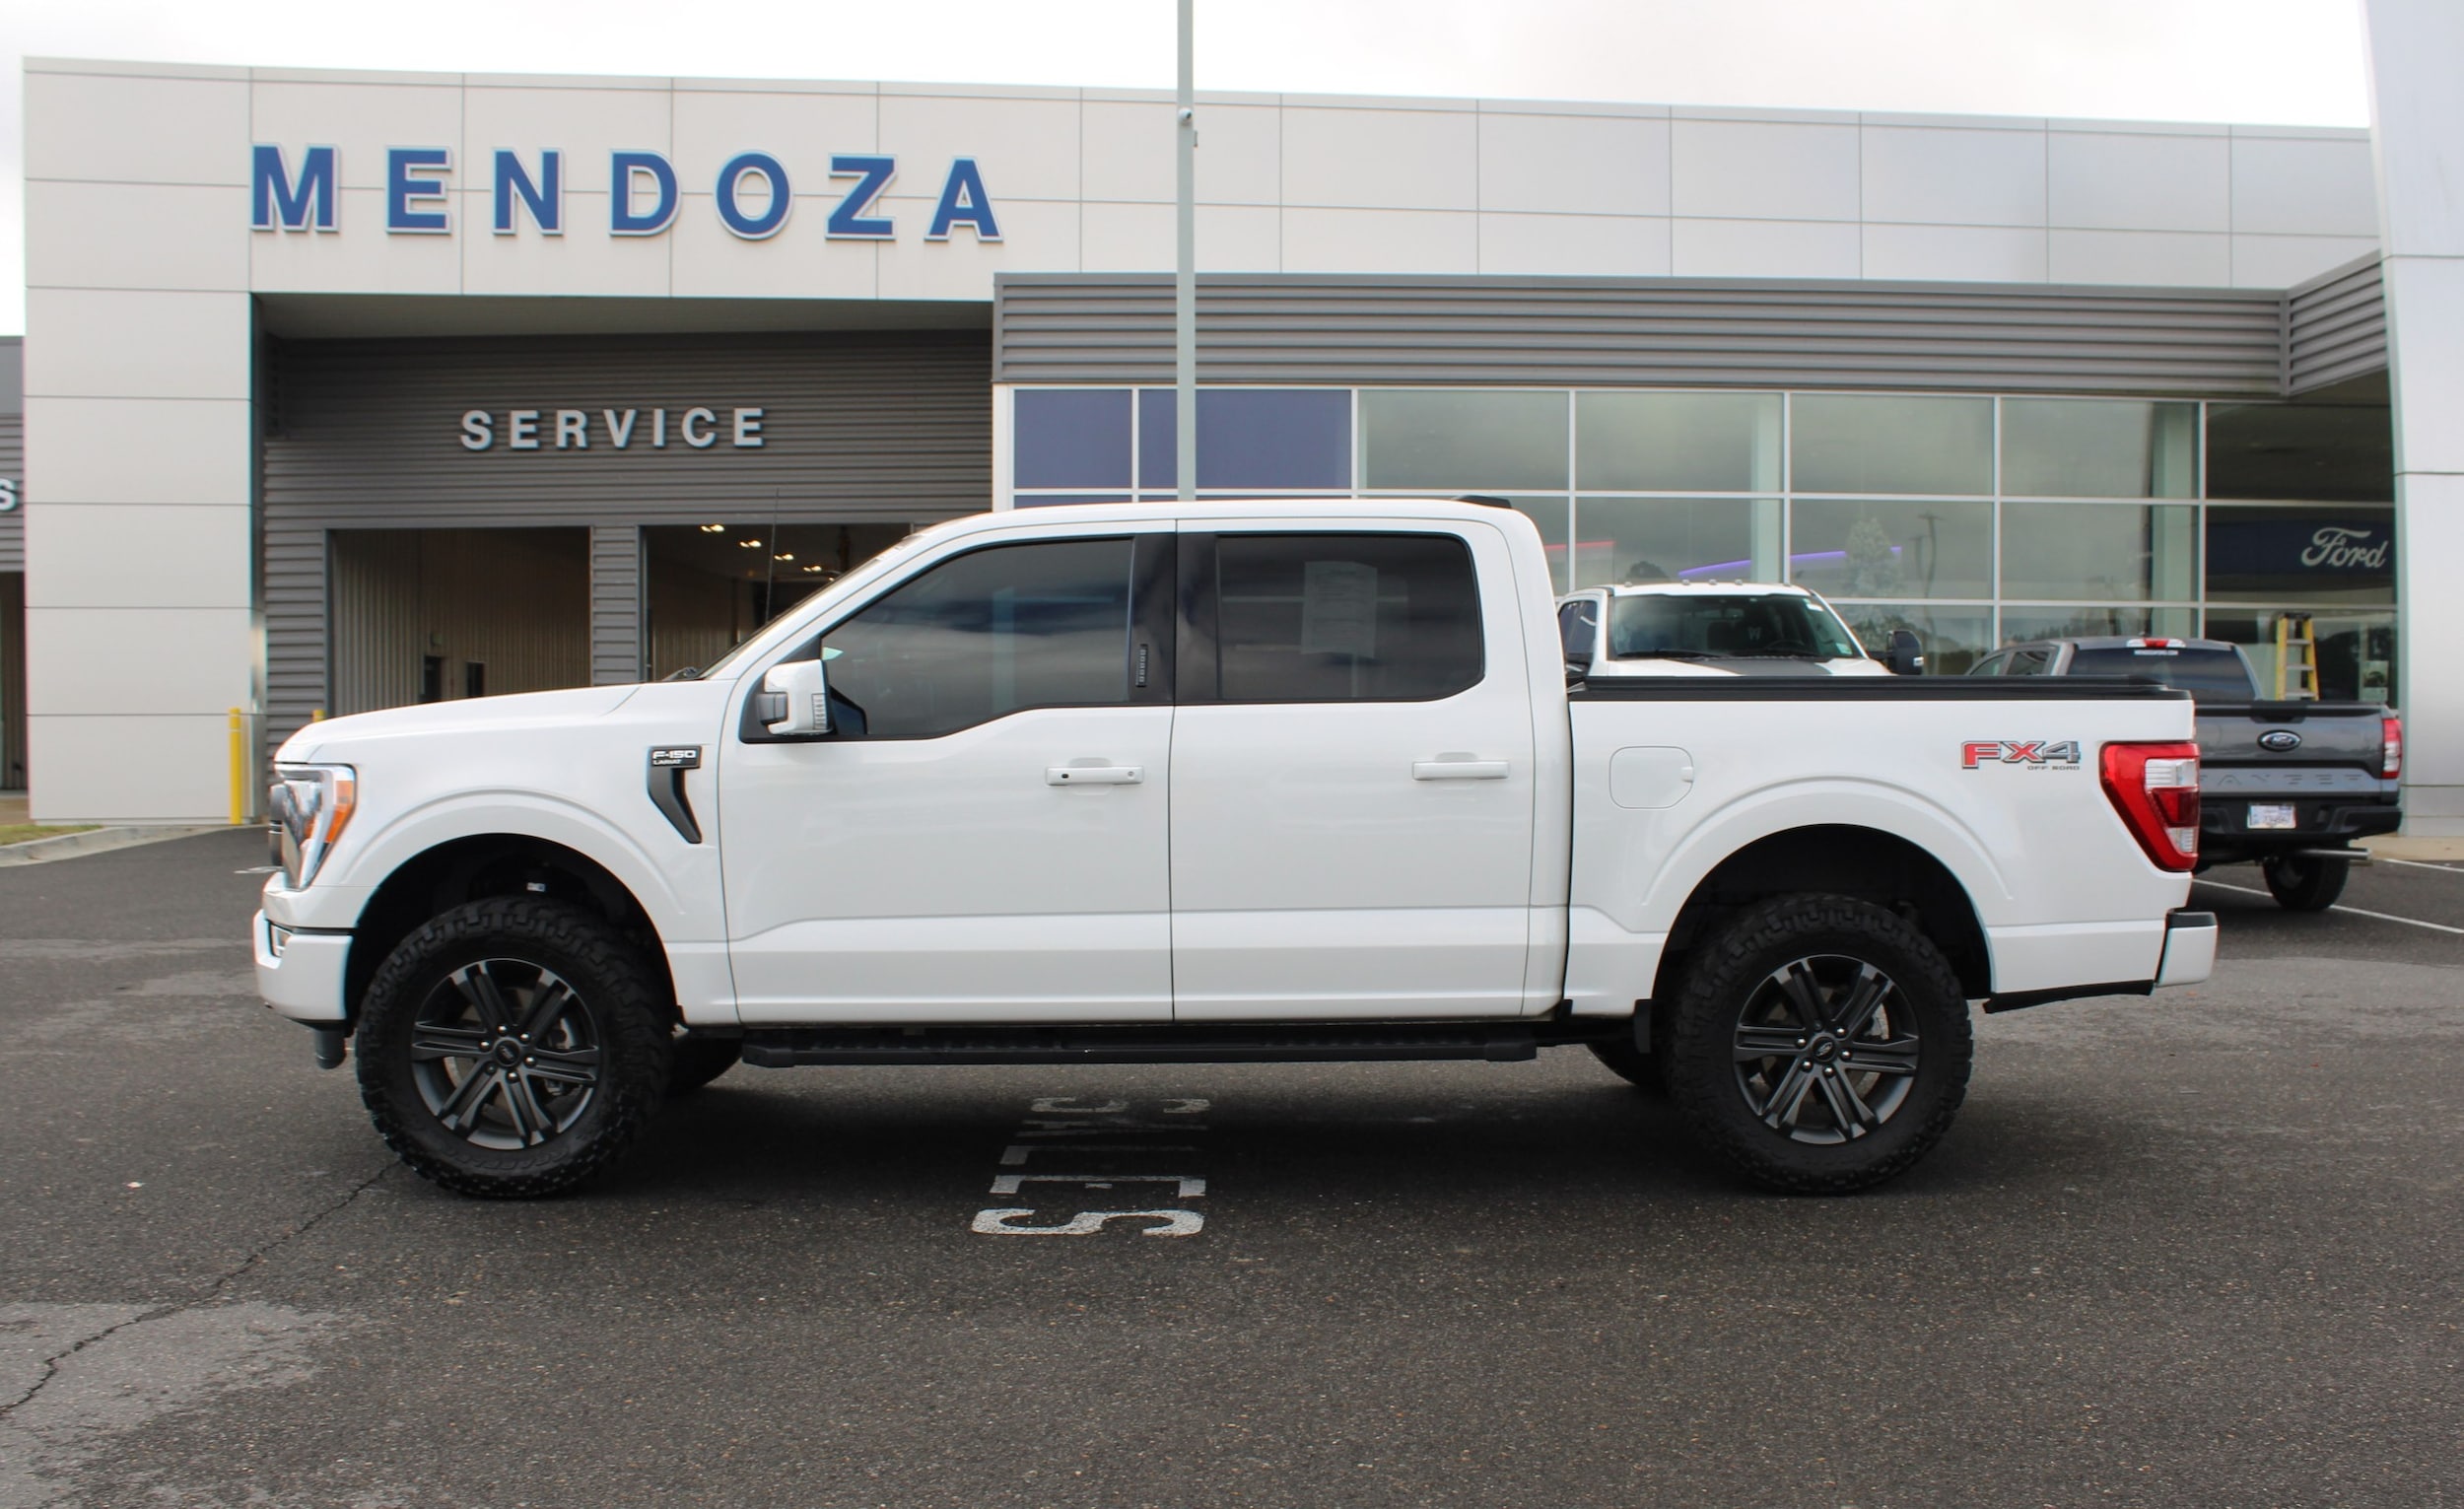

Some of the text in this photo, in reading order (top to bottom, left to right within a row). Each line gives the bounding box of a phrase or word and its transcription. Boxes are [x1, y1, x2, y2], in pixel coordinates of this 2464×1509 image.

[250, 144, 1003, 242] MENDOZA
[459, 406, 766, 450] SERVICE
[2300, 526, 2389, 569] Ford
[652, 749, 697, 759] F-150
[1961, 740, 2081, 770] FX4
